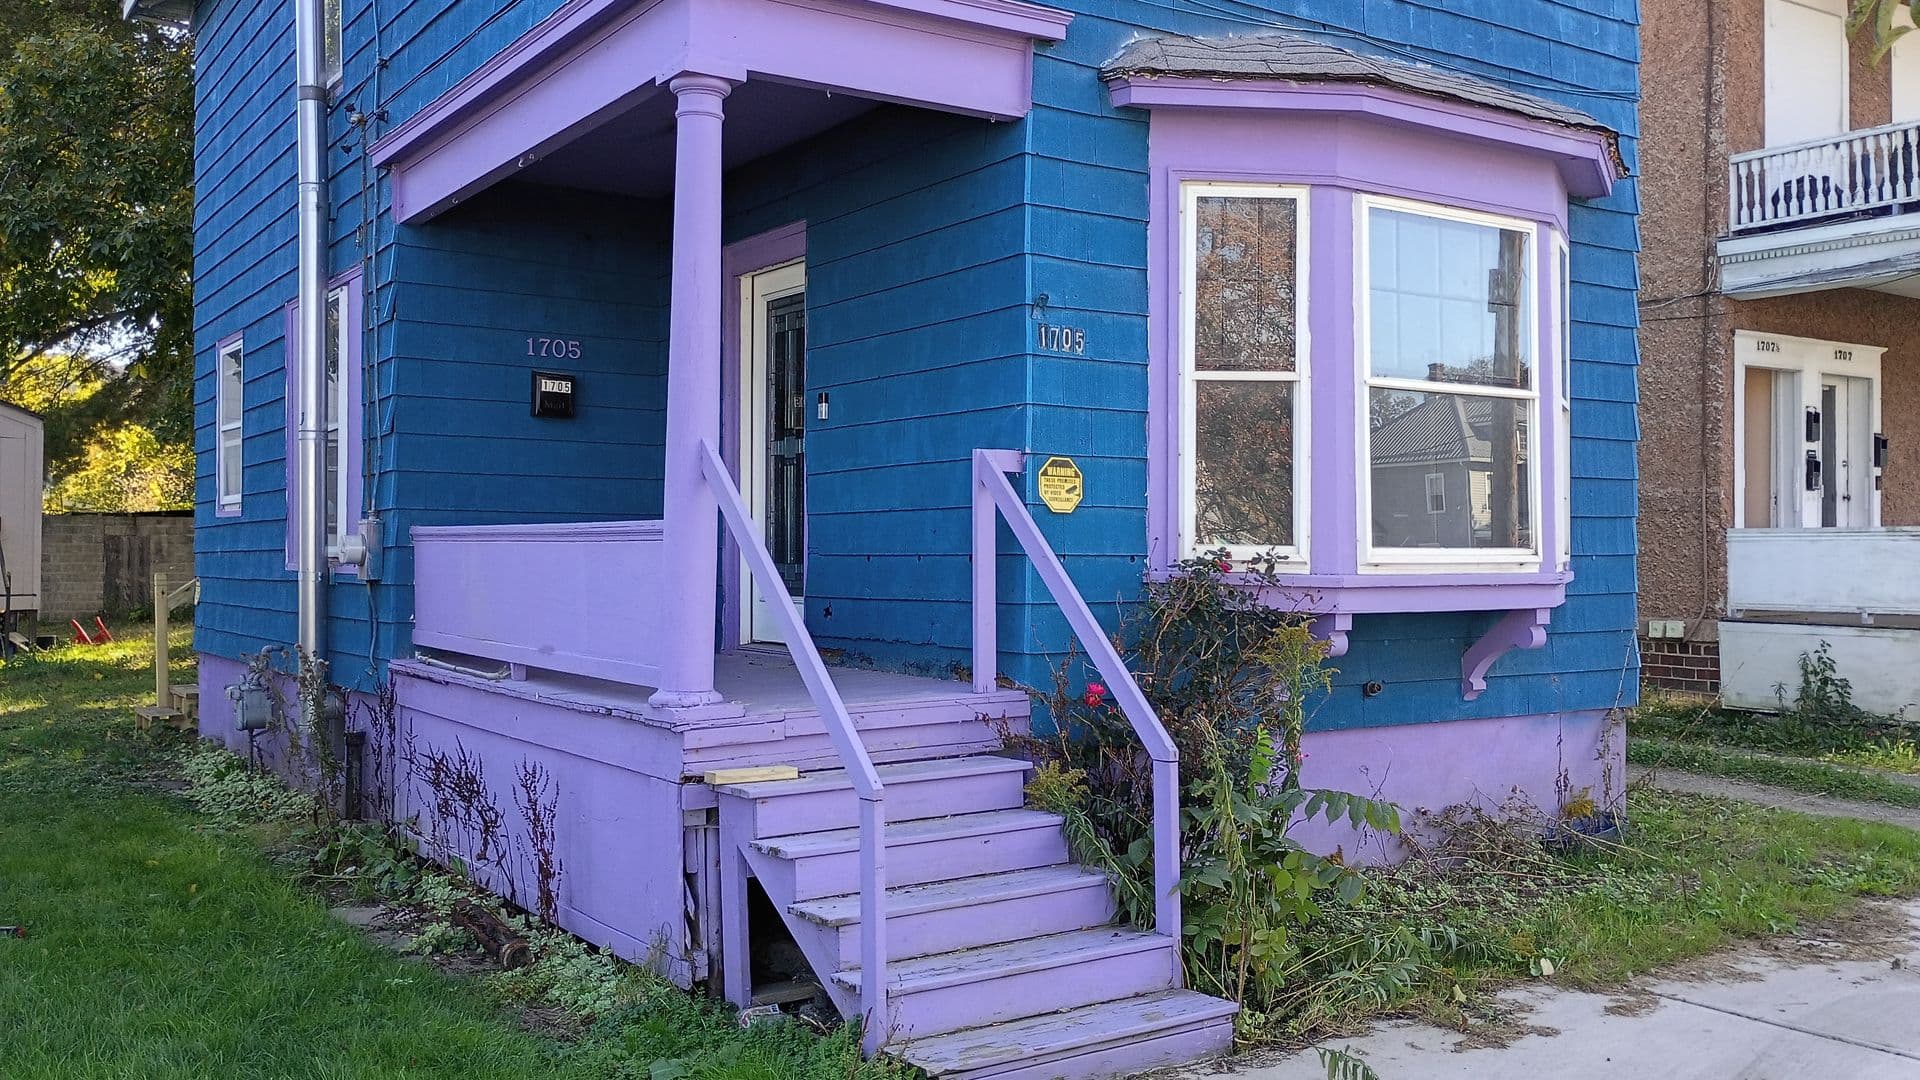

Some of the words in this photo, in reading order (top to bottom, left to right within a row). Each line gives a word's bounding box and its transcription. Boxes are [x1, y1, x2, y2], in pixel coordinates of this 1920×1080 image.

[1040, 325, 1084, 353] 1705
[527, 337, 581, 359] 1705
[1834, 350, 1853, 361] 1707
[543, 380, 570, 393] 1705
[1047, 466, 1075, 476] WARNING
